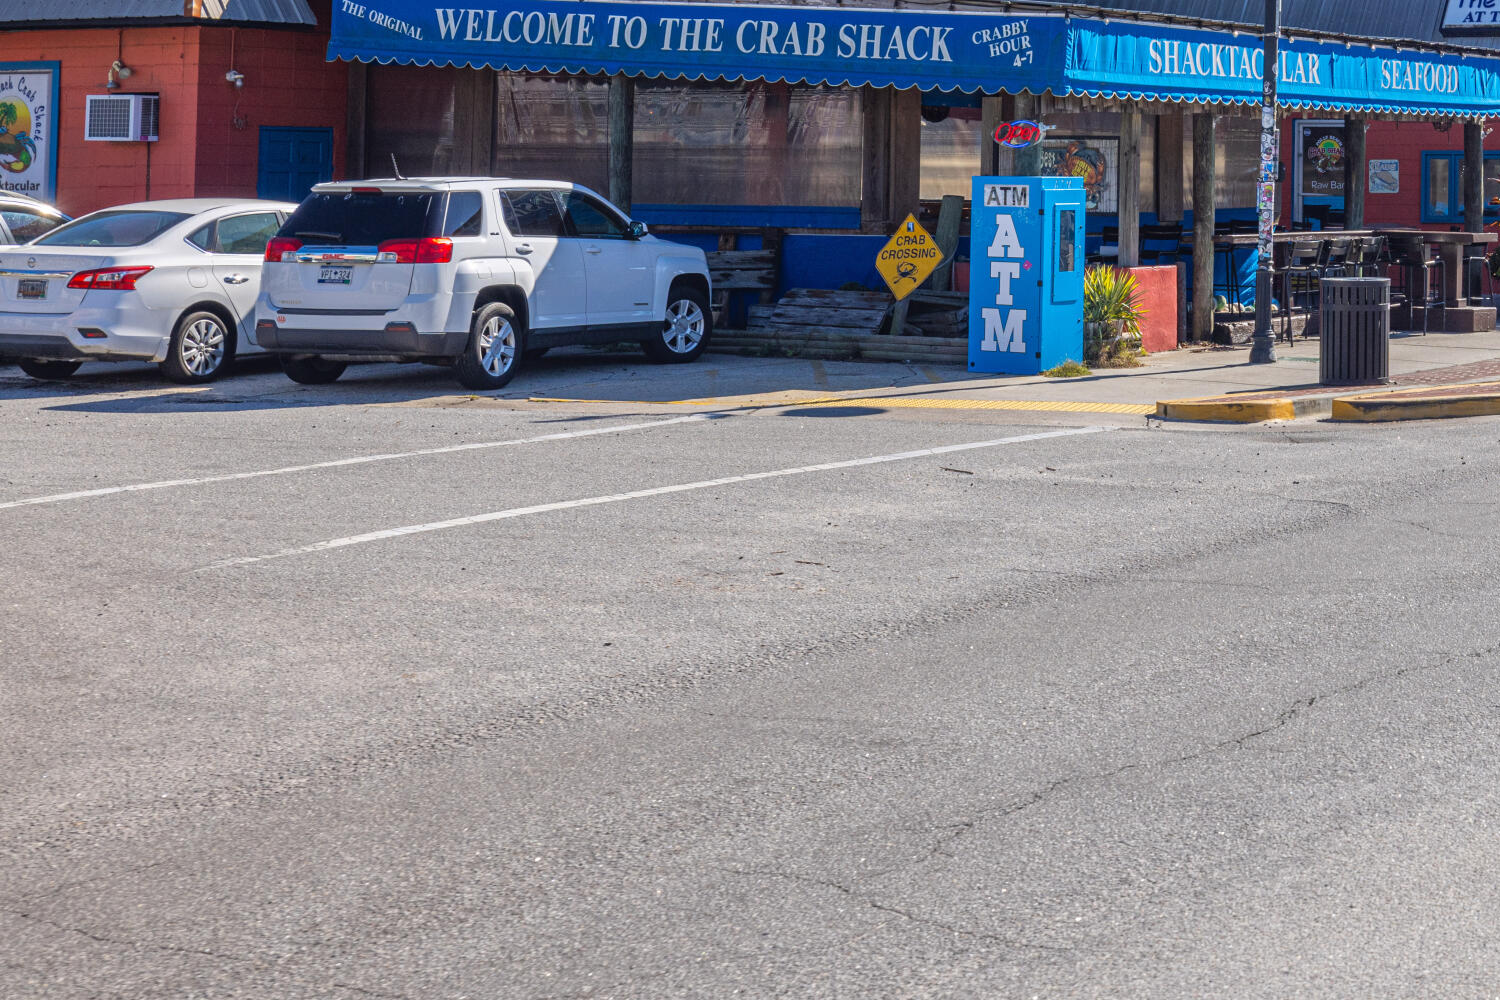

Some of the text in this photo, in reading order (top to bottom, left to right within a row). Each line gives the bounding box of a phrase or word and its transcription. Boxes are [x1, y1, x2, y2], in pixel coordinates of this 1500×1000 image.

[342, 0, 424, 40] THE ORIGINAL
[1463, 11, 1487, 23] AT
[435, 8, 954, 62] WELCOME TO THE CRAB SHACK
[972, 19, 1029, 45] CRABBY
[989, 35, 1032, 57] HOUR
[1013, 50, 1033, 67] 4-7
[1149, 39, 1459, 93] SHACKTACLAR SEAFOOD
[995, 123, 1040, 143] Open
[1311, 181, 1329, 189] Raw
[986, 186, 1028, 206] ATM
[896, 235, 926, 247] CRAB
[881, 248, 937, 261] CROSSING
